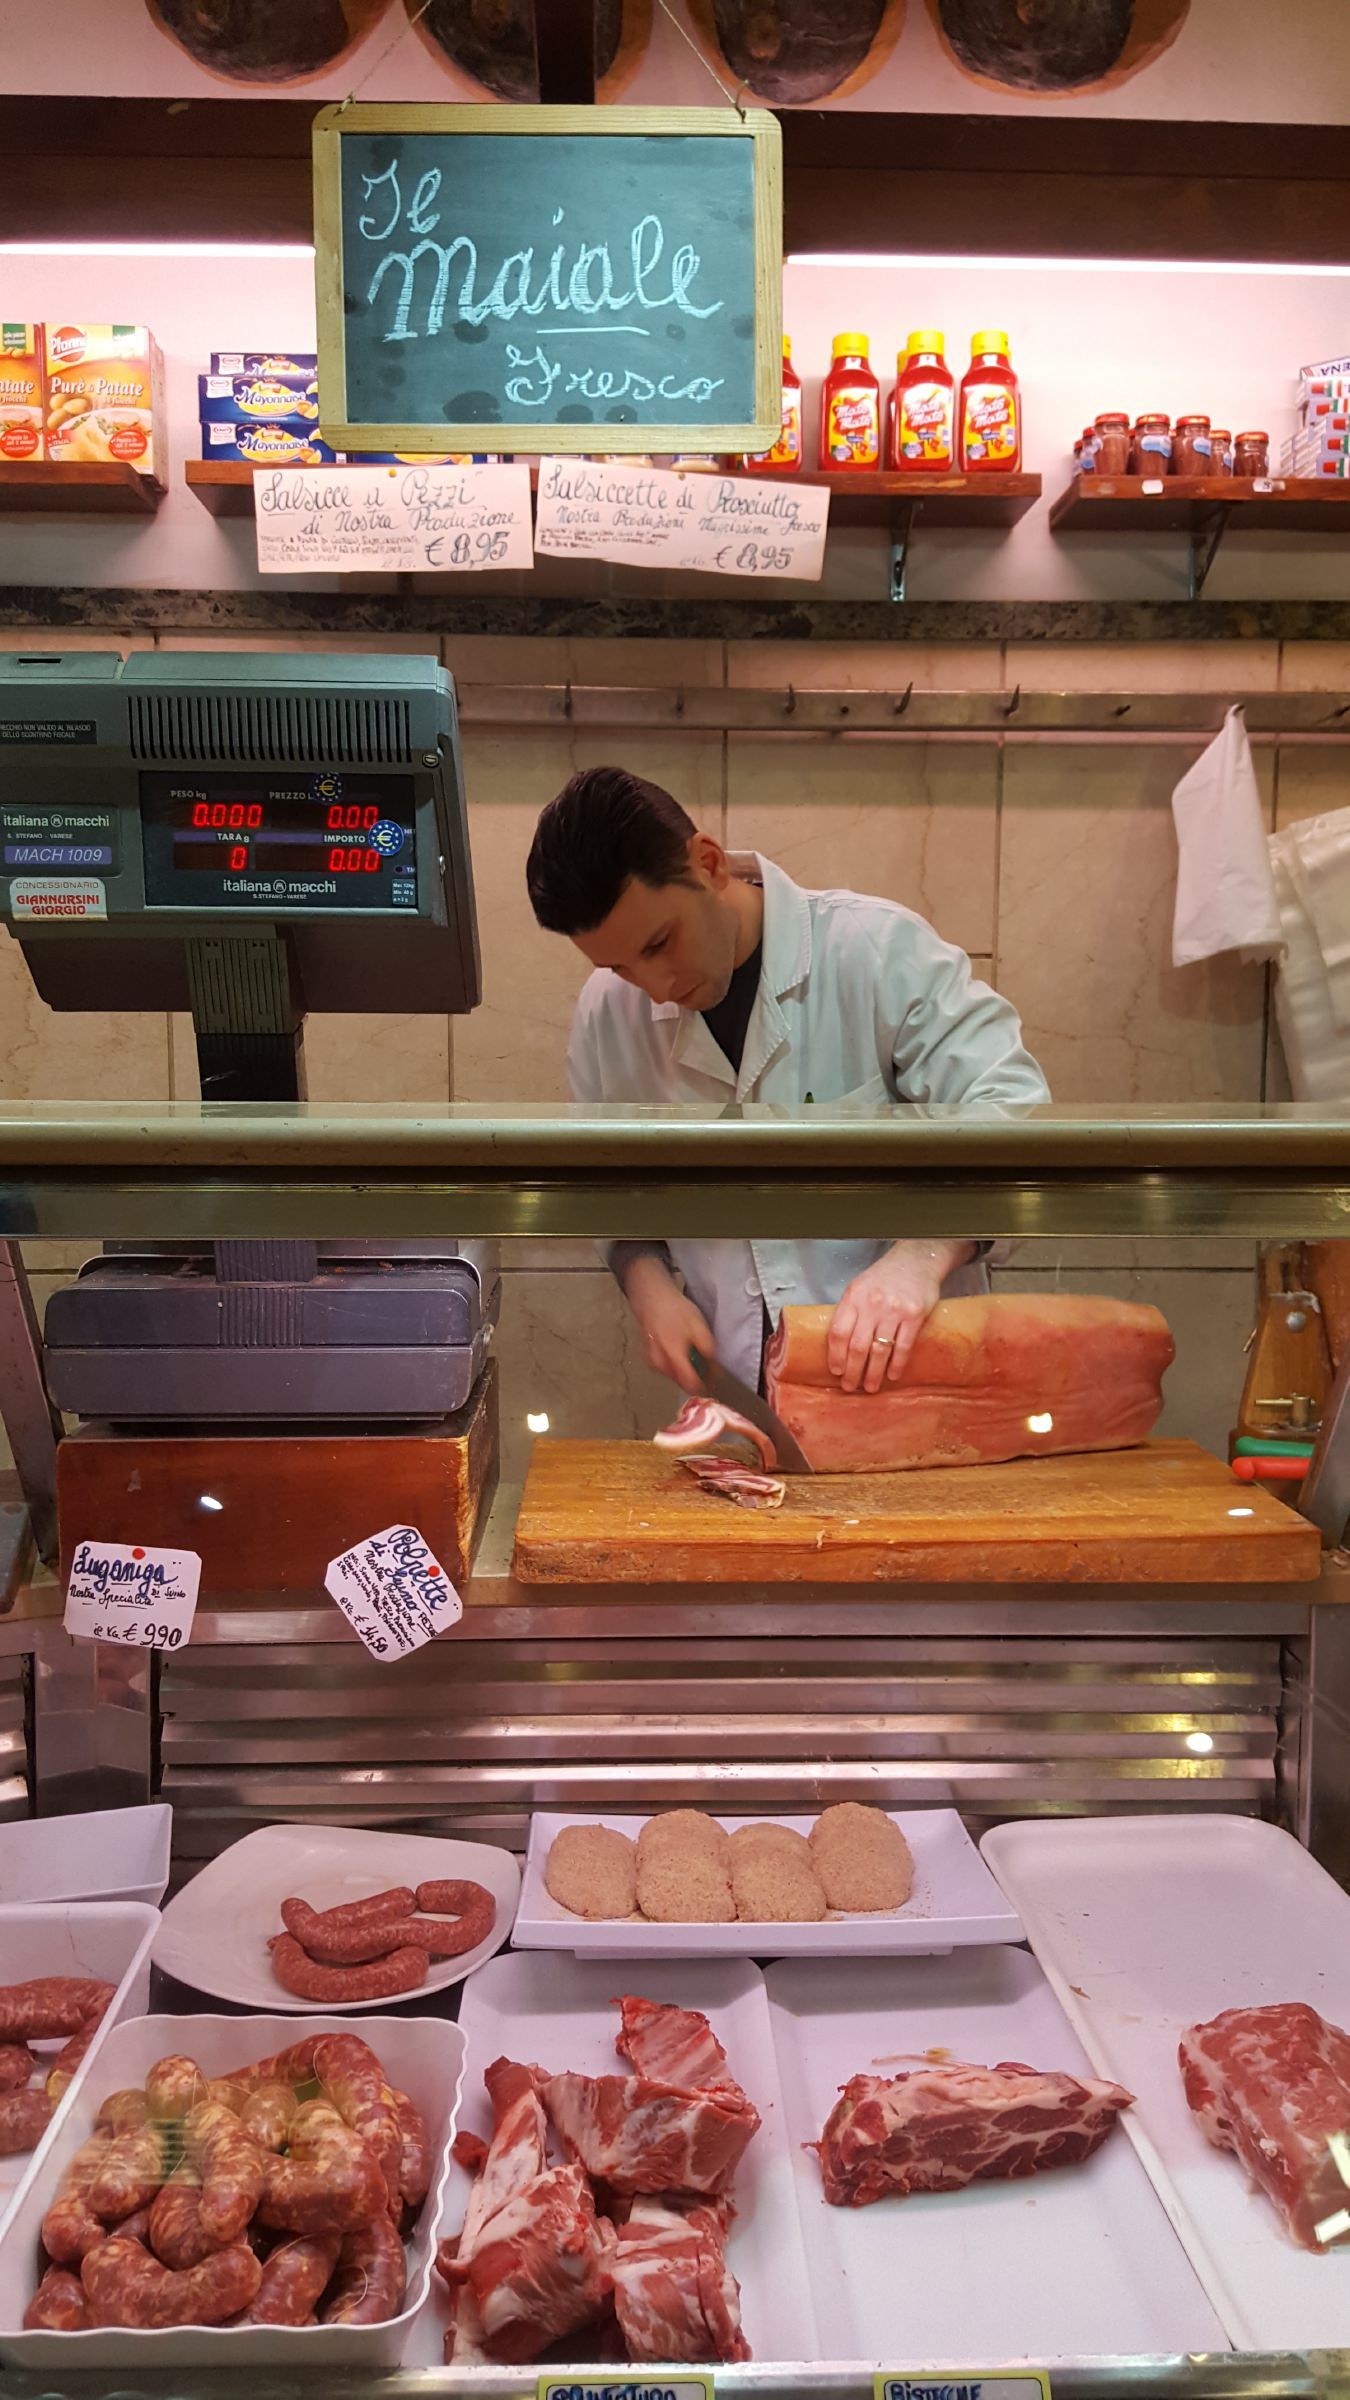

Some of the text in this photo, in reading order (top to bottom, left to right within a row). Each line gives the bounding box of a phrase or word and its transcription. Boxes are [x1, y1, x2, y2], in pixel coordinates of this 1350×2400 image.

[360, 159, 441, 240] Il
[368, 208, 725, 342] Maiale
[505, 345, 725, 405] Fresco
[95, 378, 143, 396] Patate
[235, 386, 305, 405] Mayonnaise
[238, 432, 308, 451] Mayonnaise
[261, 472, 352, 512] Salsicce
[401, 469, 475, 509] Pezzi
[543, 464, 668, 509] Salsiccette
[301, 507, 521, 534] di Nostra Produzione
[557, 505, 600, 524] Nostra
[425, 536, 445, 566] €
[450, 531, 510, 568] 8,95
[713, 545, 733, 569] €
[736, 542, 794, 572] 8,95
[170, 790, 207, 800] PESO kg
[269, 791, 306, 800] PREZZO
[3, 815, 110, 827] italiana macchi
[193, 803, 262, 828] 0.000
[328, 805, 379, 829] 0.00
[217, 833, 242, 841] TARA
[324, 835, 366, 843] IMPORTO
[14, 849, 103, 862] MACH 1009
[231, 847, 247, 870] 0
[329, 848, 380, 872] 0.00
[16, 881, 99, 889] CONCESSIONARIO
[223, 880, 336, 893] italiana macchi
[16, 894, 100, 905] GIANNURSINI
[32, 905, 86, 915] GIORGIO
[74, 1546, 179, 1598] Luganiga
[369, 1540, 390, 1557] di
[384, 1565, 421, 1611] Suino
[387, 1528, 448, 1611] Polpette
[70, 1584, 97, 1600] Nostra
[123, 1623, 138, 1641] €
